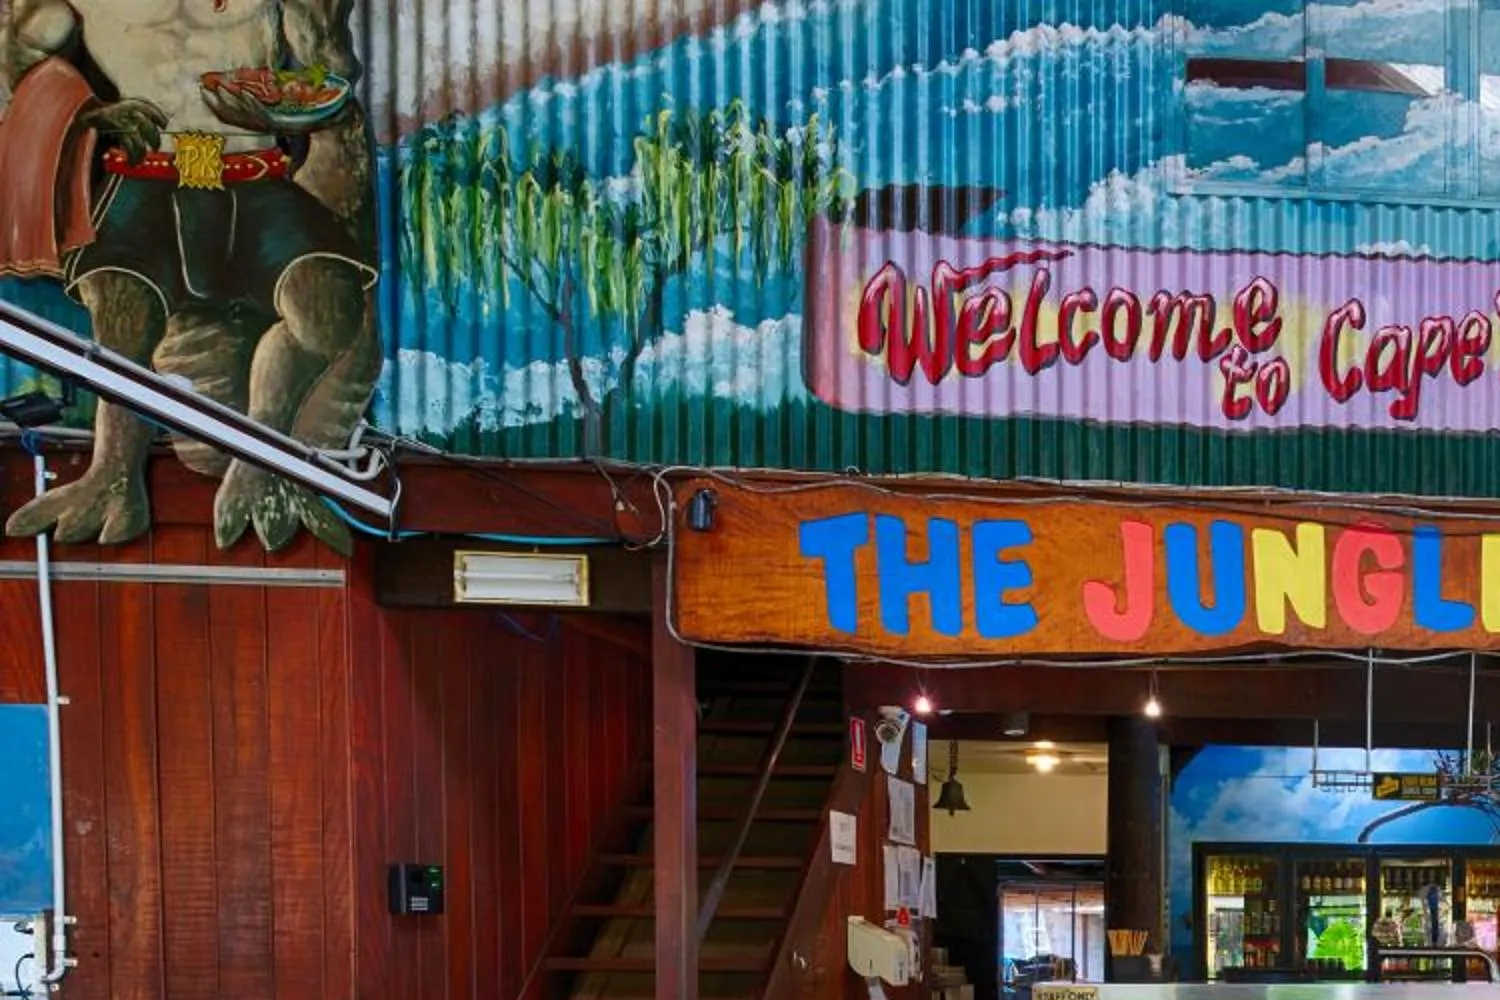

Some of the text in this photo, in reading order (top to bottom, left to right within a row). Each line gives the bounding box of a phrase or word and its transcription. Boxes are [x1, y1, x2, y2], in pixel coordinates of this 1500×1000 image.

[182, 145, 217, 180] PK
[857, 246, 1283, 387] Welcome
[1219, 342, 1291, 421] to
[799, 513, 1038, 640] THE
